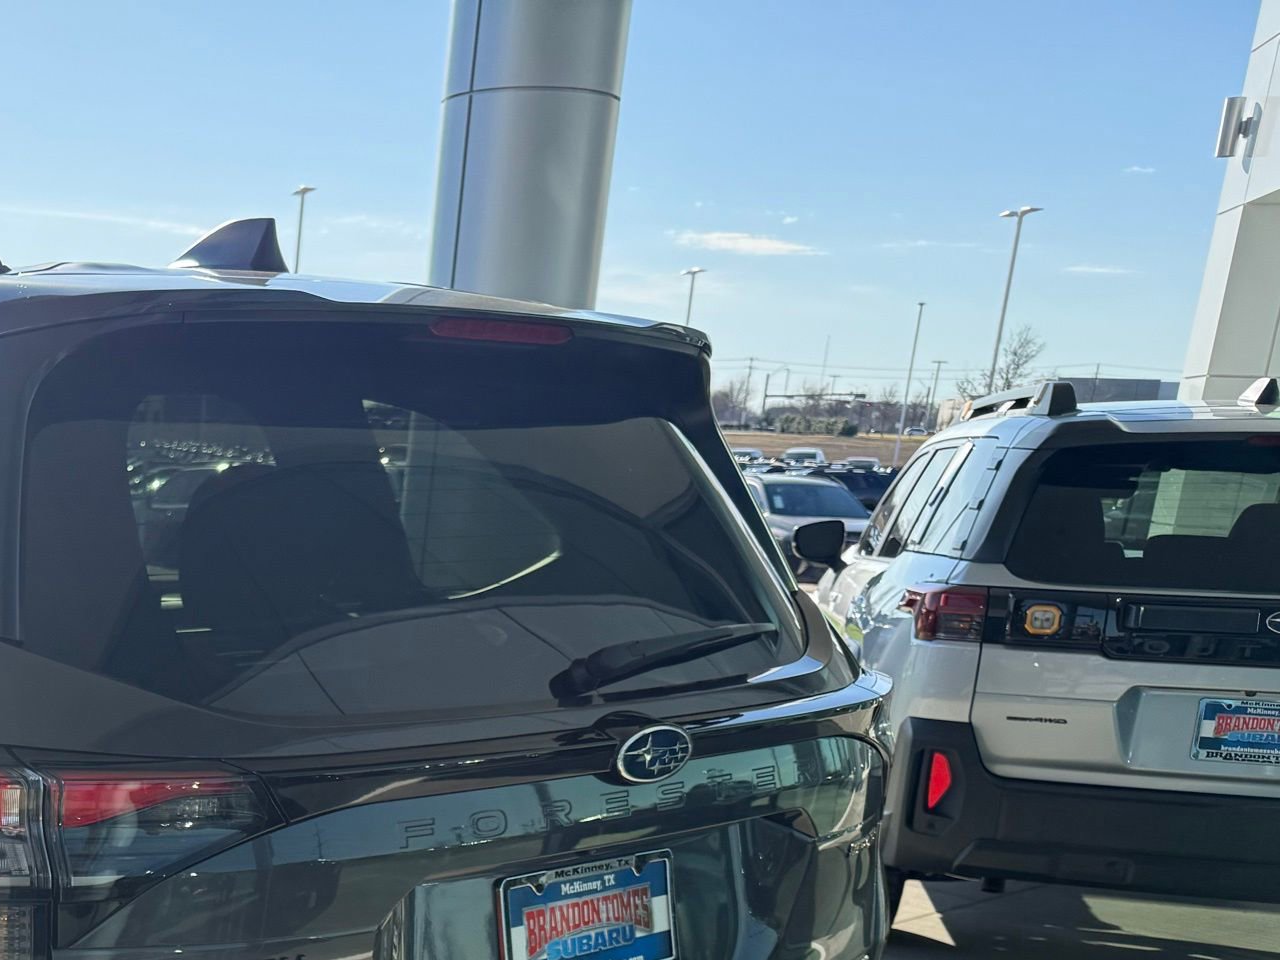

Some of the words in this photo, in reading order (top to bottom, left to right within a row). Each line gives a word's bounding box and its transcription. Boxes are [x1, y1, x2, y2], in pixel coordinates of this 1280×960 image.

[1214, 715, 1275, 736] BRANDON
[554, 863, 613, 879] McKinney,
[604, 874, 616, 886] TX
[524, 897, 602, 957] BRANDON
[602, 884, 652, 930] TOMES
